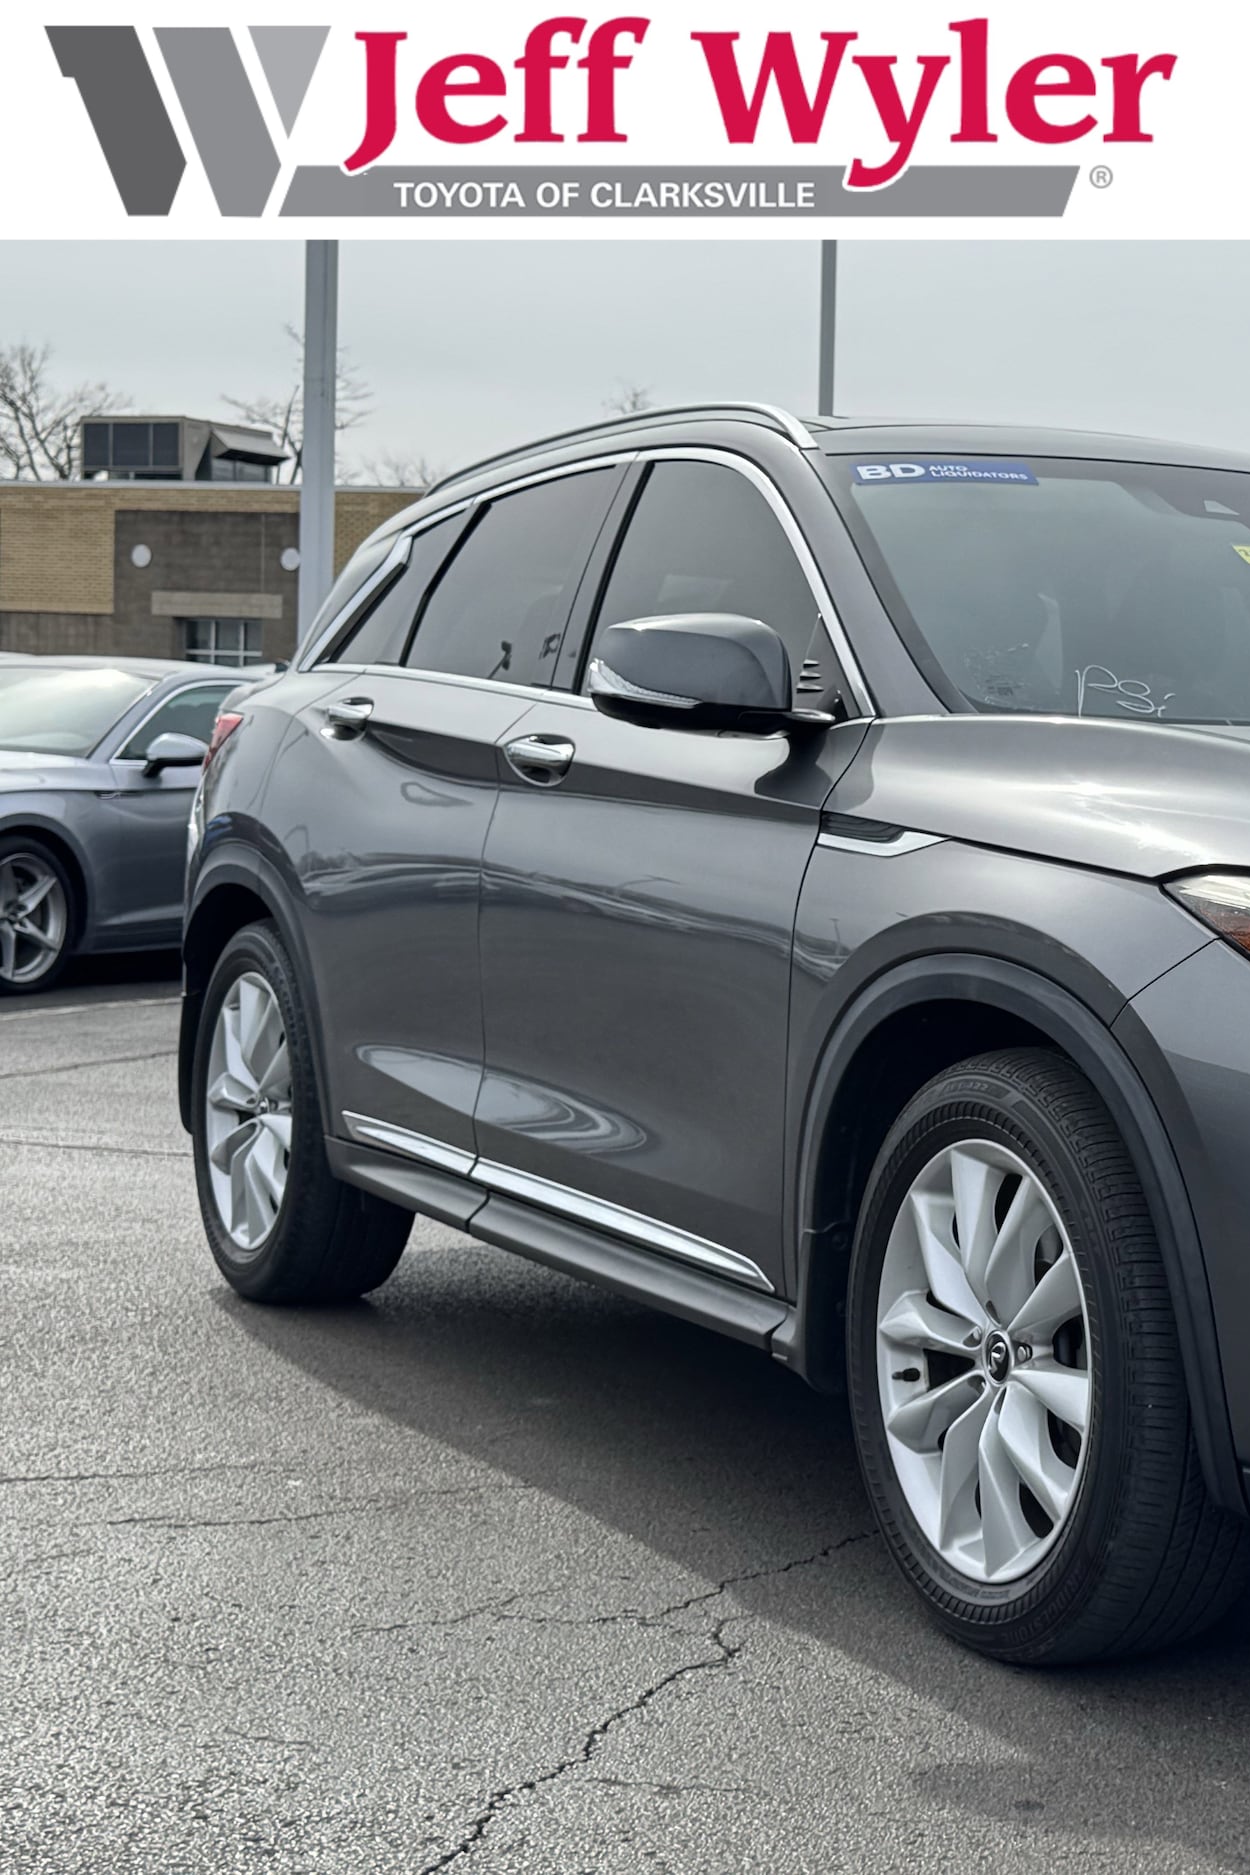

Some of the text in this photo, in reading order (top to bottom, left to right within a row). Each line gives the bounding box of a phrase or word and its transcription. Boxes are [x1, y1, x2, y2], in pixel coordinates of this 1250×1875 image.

[857, 463, 926, 480] BD
[929, 464, 968, 472] AUTO
[930, 470, 1028, 480] LIQUIDATORS
